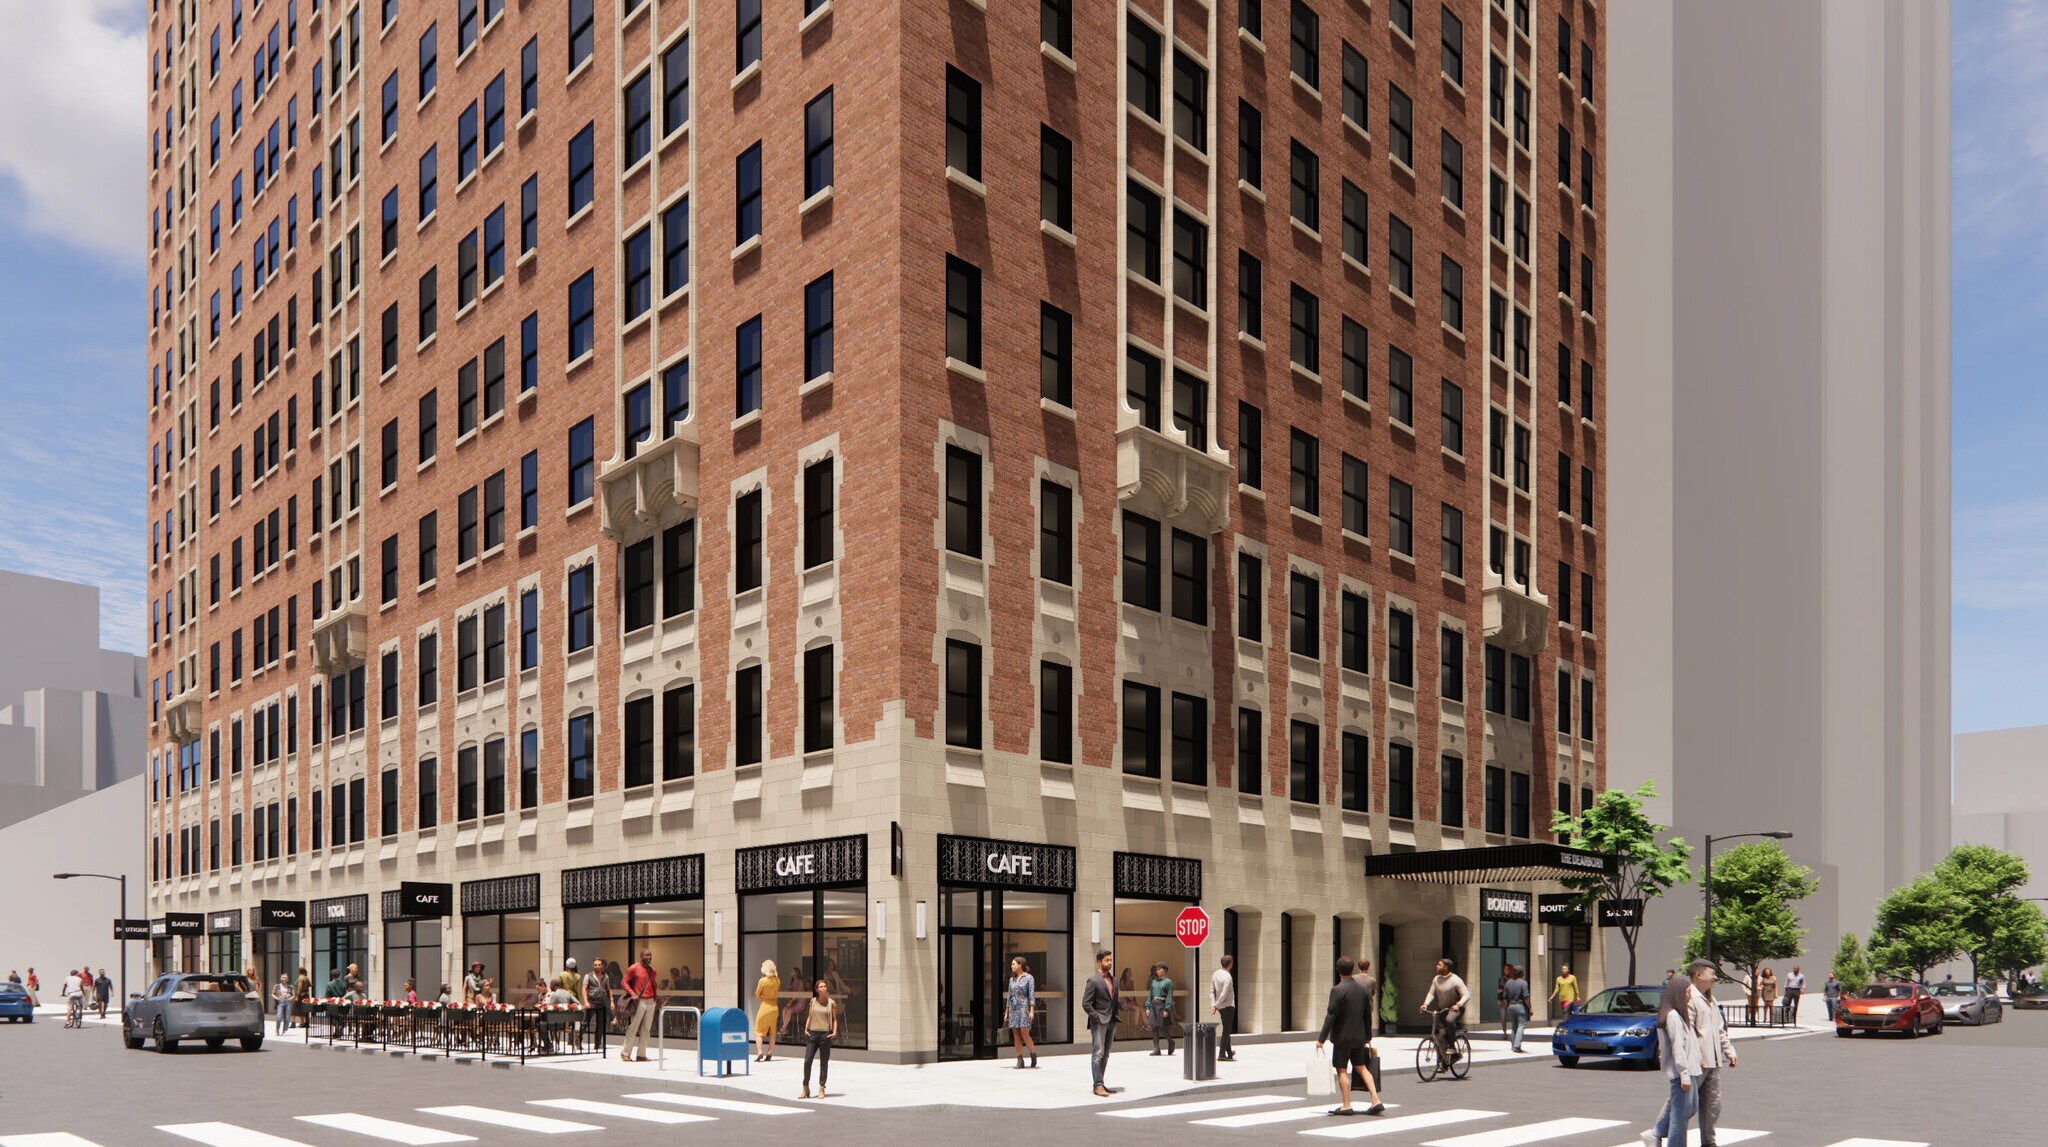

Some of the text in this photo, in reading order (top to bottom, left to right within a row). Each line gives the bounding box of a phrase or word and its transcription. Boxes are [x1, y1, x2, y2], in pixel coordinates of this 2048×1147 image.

[776, 854, 815, 876] CAFE
[987, 853, 1032, 875] CAFE
[415, 895, 439, 904] CAFE
[1487, 897, 1527, 914] BOUTIQUE
[271, 910, 296, 918] YOGA
[327, 904, 345, 918] YOGA
[1178, 918, 1207, 936] STOP
